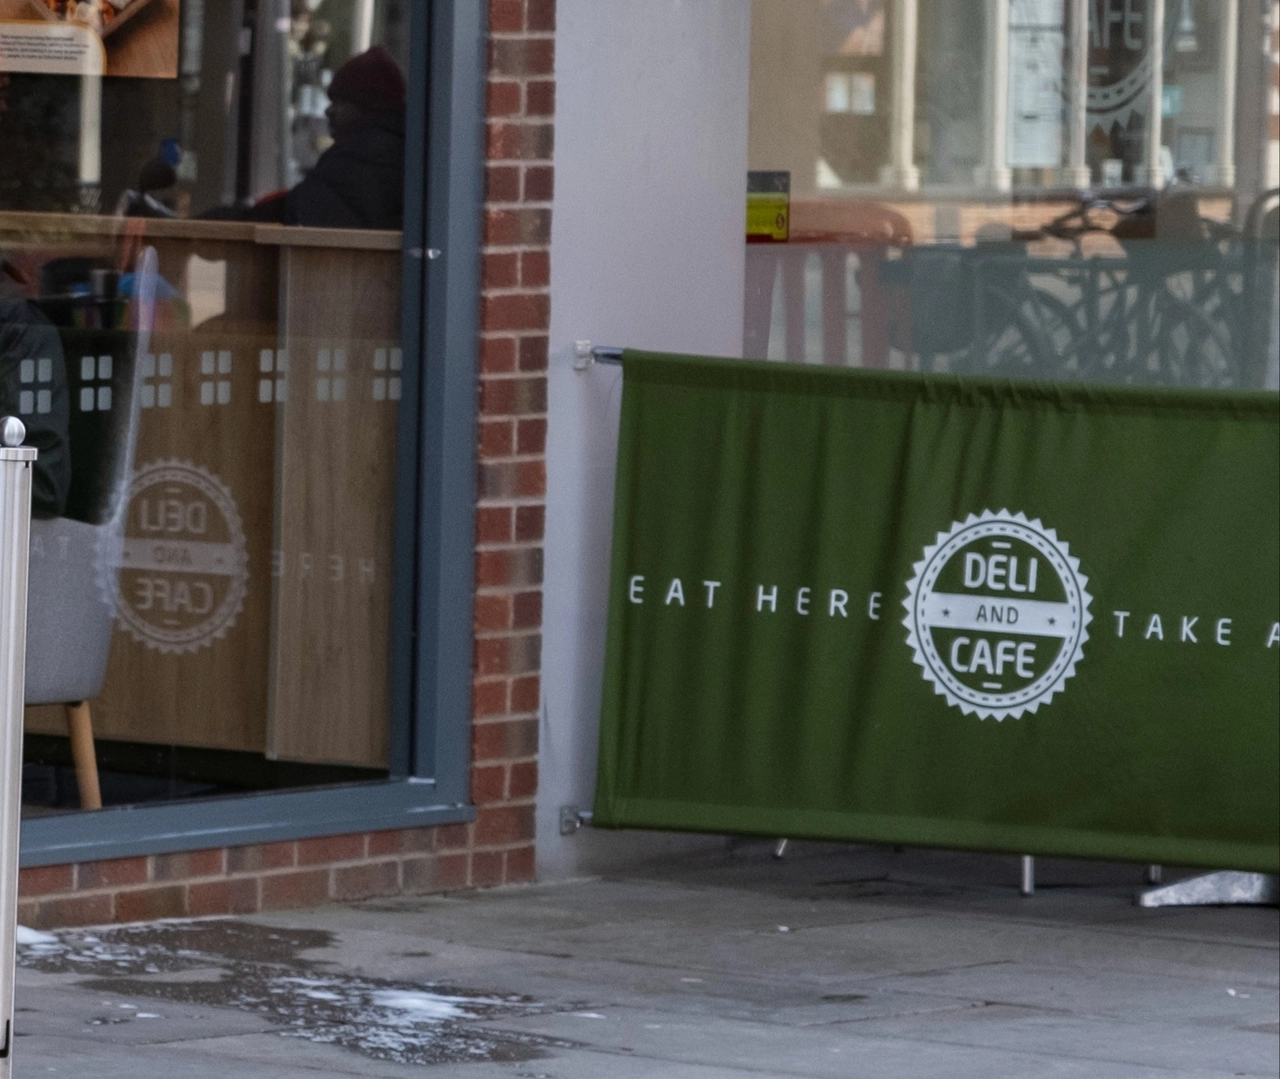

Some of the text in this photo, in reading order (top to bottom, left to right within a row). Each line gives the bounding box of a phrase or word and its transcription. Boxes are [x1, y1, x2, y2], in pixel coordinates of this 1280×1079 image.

[964, 552, 1038, 593] DELI
[629, 575, 721, 609] EAT
[756, 584, 882, 620] HERE
[1113, 610, 1232, 646] TAKE
[976, 604, 1019, 625] AND
[950, 636, 1036, 678] CAFE
